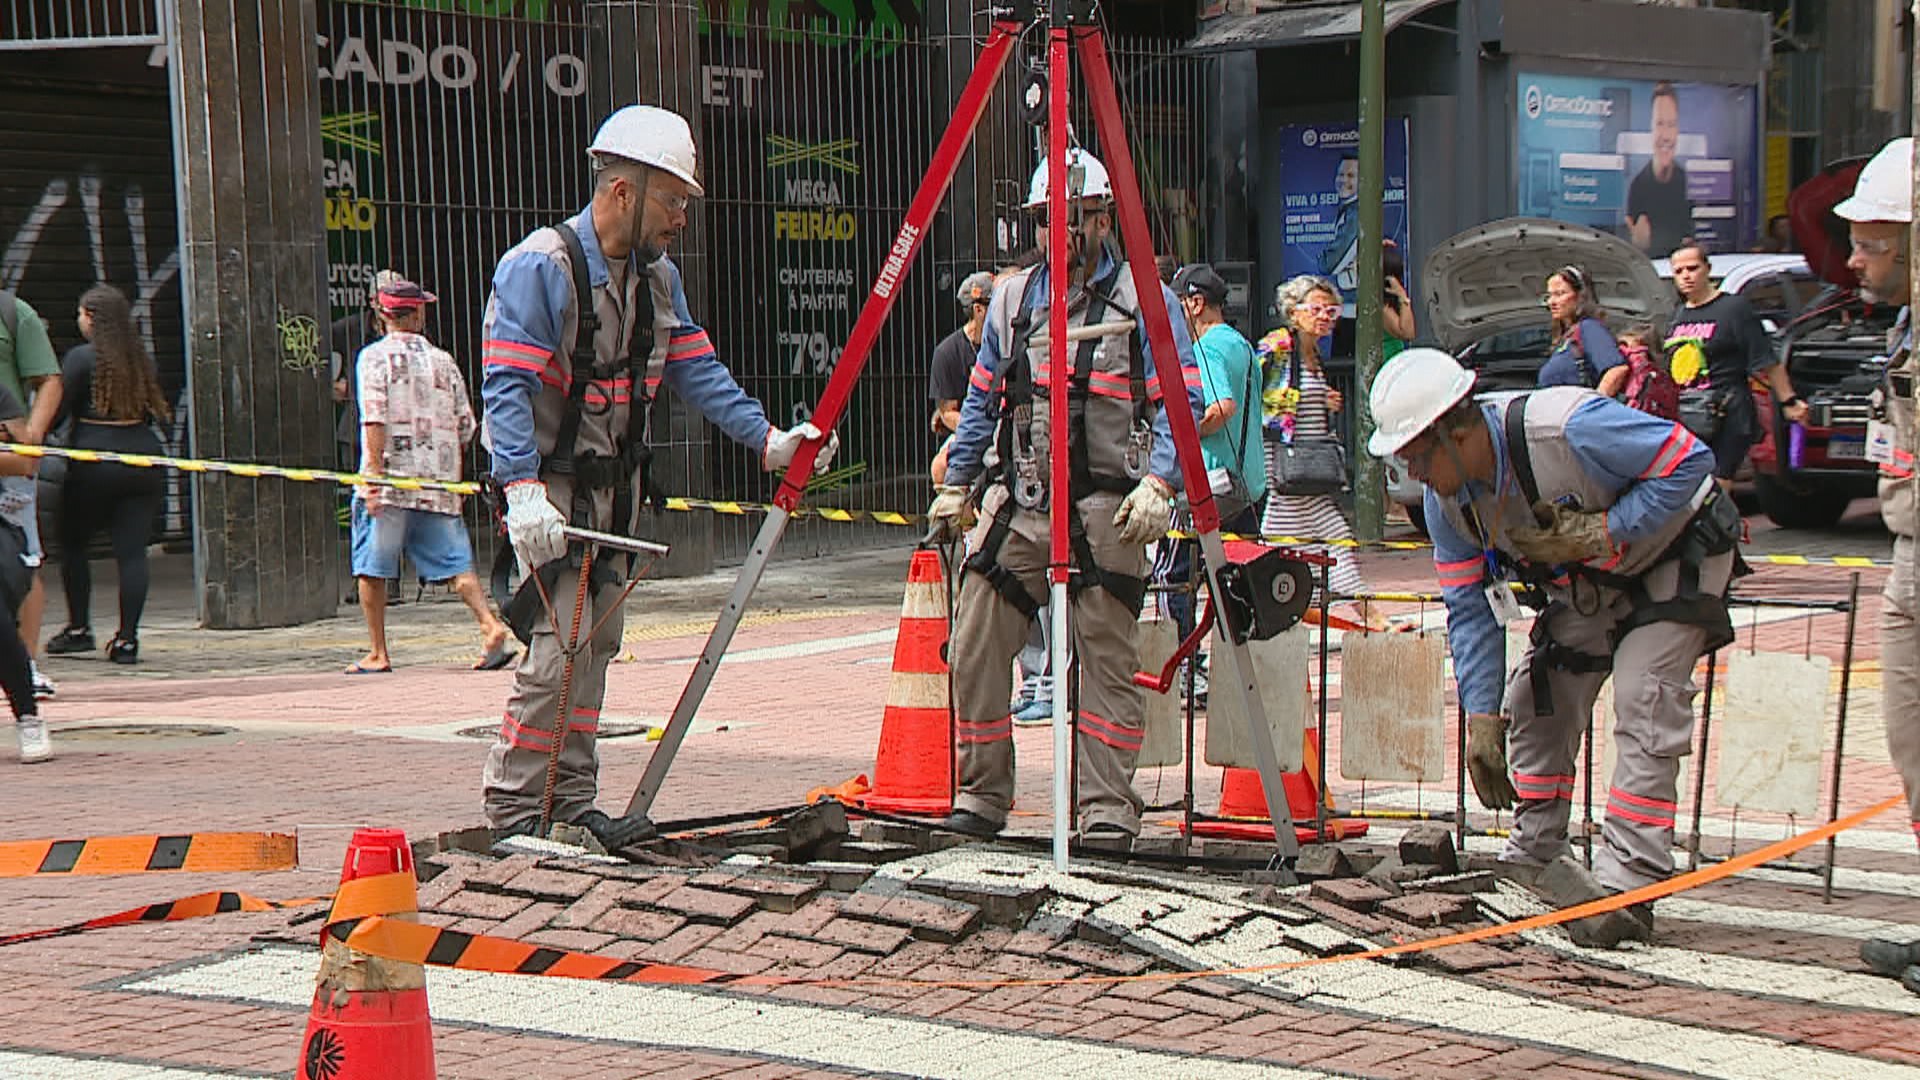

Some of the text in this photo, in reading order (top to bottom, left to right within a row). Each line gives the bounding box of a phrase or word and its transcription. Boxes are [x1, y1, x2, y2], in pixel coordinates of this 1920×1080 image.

[784, 179, 841, 205] MEGA
[1286, 195, 1308, 207] VIVA
[1311, 193, 1318, 205] O
[1320, 193, 1339, 205] SEU
[775, 206, 856, 241] FEIRÃO
[873, 220, 920, 299] ULTRA SAFE
[779, 268, 854, 285] CHUTEIRAS
[802, 293, 847, 311] PARTIR
